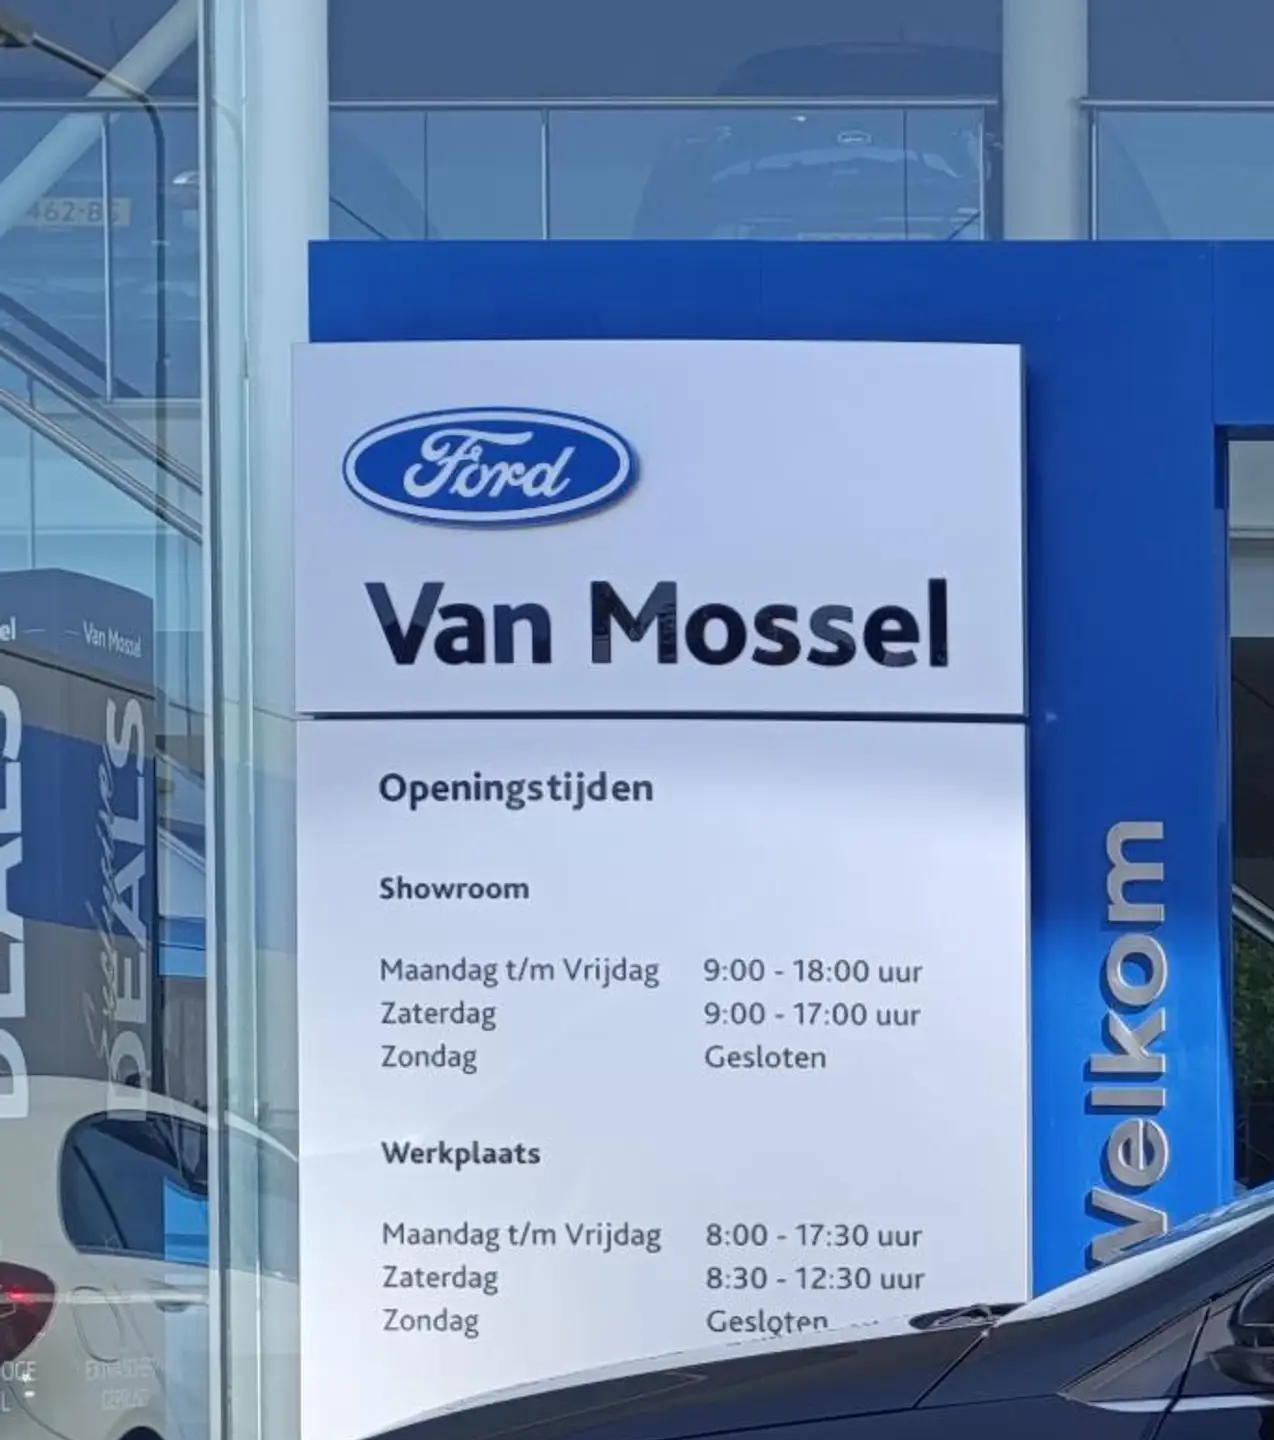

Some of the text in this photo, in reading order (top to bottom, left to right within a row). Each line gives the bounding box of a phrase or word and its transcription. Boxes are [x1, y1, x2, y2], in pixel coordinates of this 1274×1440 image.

[402, 426, 576, 499] Ford
[364, 577, 950, 669] Van Mossel
[378, 770, 654, 812] Openingstijden
[379, 874, 530, 901] Showroom
[106, 697, 147, 1121] DEALS
[380, 955, 660, 989] Maandag t/m Vrijdag
[703, 957, 765, 982] 9:00
[792, 958, 870, 984] 18:00
[878, 965, 924, 984] uur
[380, 999, 497, 1032] Zaterdag
[703, 1001, 766, 1026] 9:00
[793, 1001, 868, 1027] 17:00
[876, 1008, 922, 1027] uur
[380, 1042, 478, 1075] Zondag
[704, 1043, 827, 1070] Gesloten
[380, 1139, 541, 1173] Werkplaats
[382, 1220, 663, 1254] Maandag t/m Vrijdag
[705, 1222, 769, 1247] 8:00
[795, 1223, 869, 1248] 17:30
[877, 1229, 923, 1248] uur
[382, 1264, 499, 1297] Zaterdag
[706, 1266, 768, 1290] 8:30
[795, 1266, 872, 1290] 12:30
[880, 1272, 926, 1291] uur
[383, 1307, 480, 1340] Zondag
[706, 1308, 829, 1334] Gesloten
